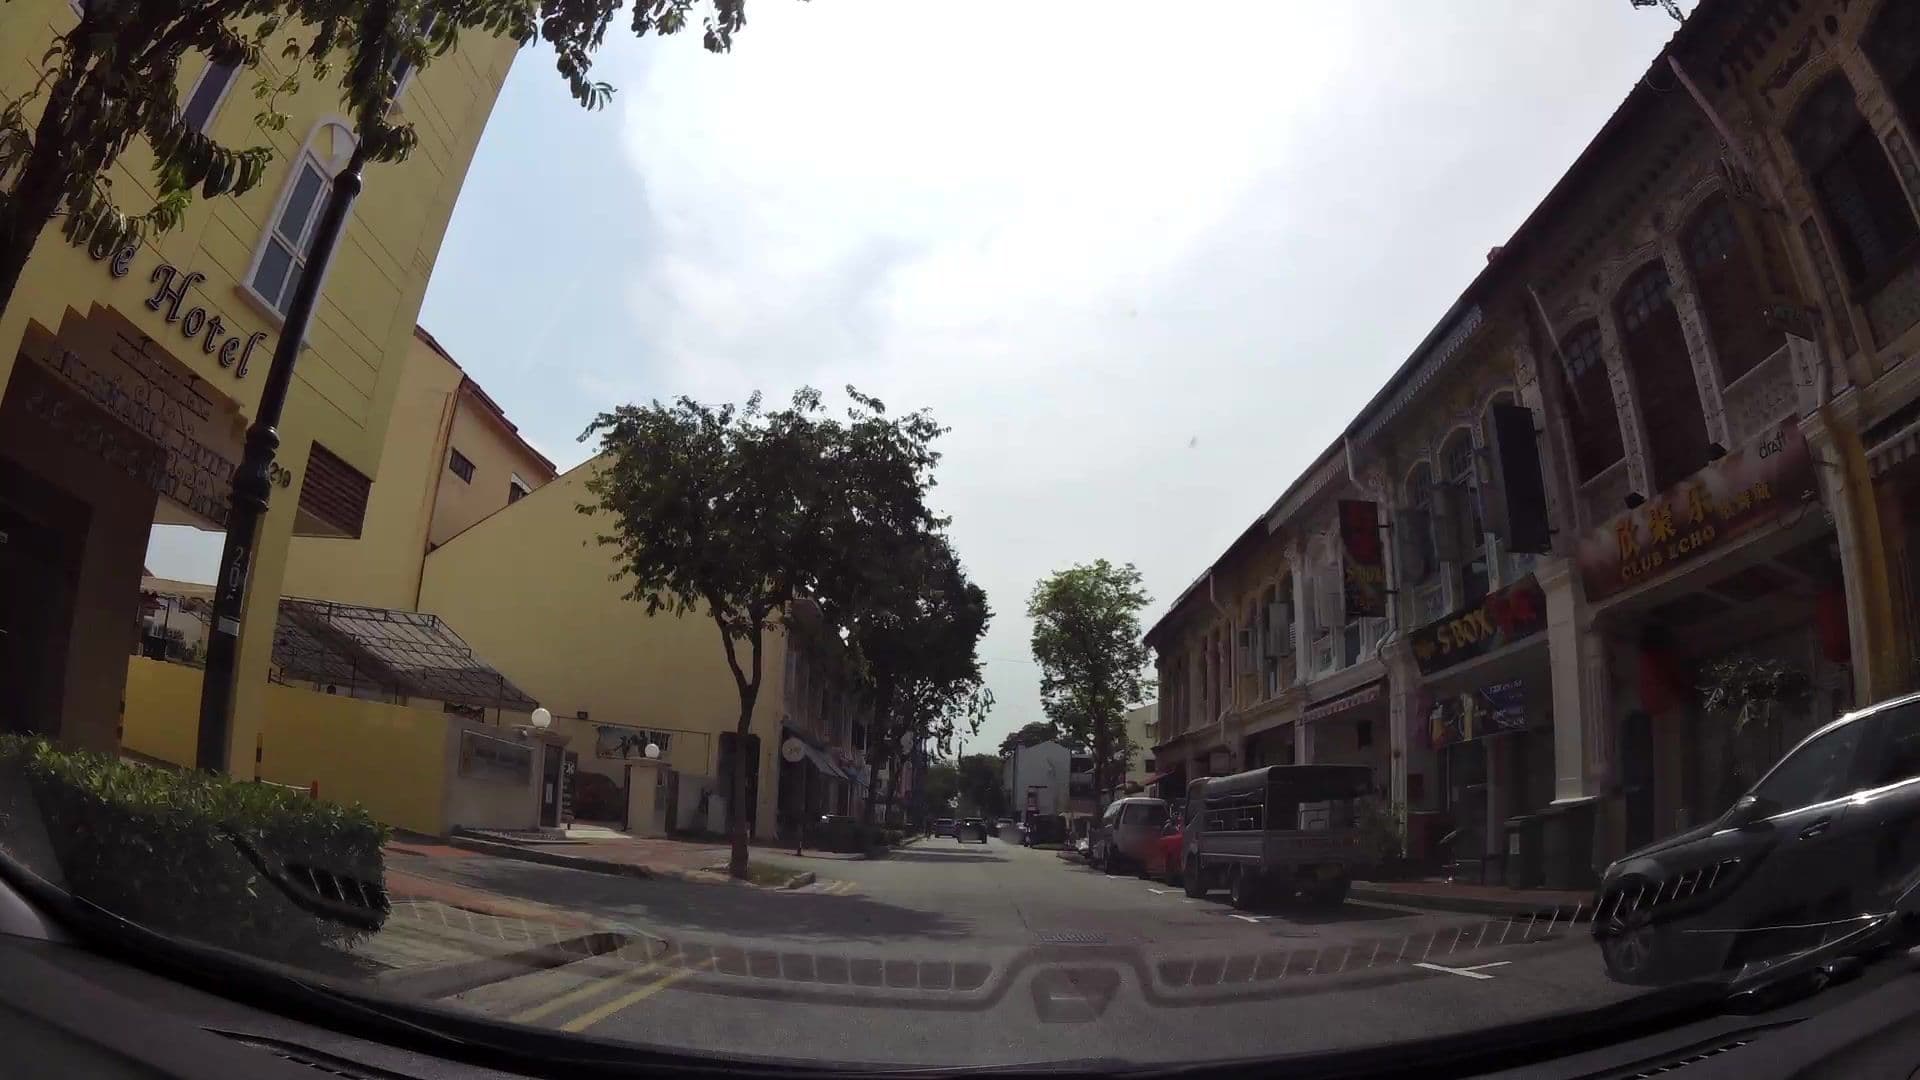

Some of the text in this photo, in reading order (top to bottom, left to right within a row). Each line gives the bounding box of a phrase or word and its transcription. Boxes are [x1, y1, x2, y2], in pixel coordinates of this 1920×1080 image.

[146, 263, 268, 379] Hotel
[1622, 525, 1716, 578] CLUB ECHO
